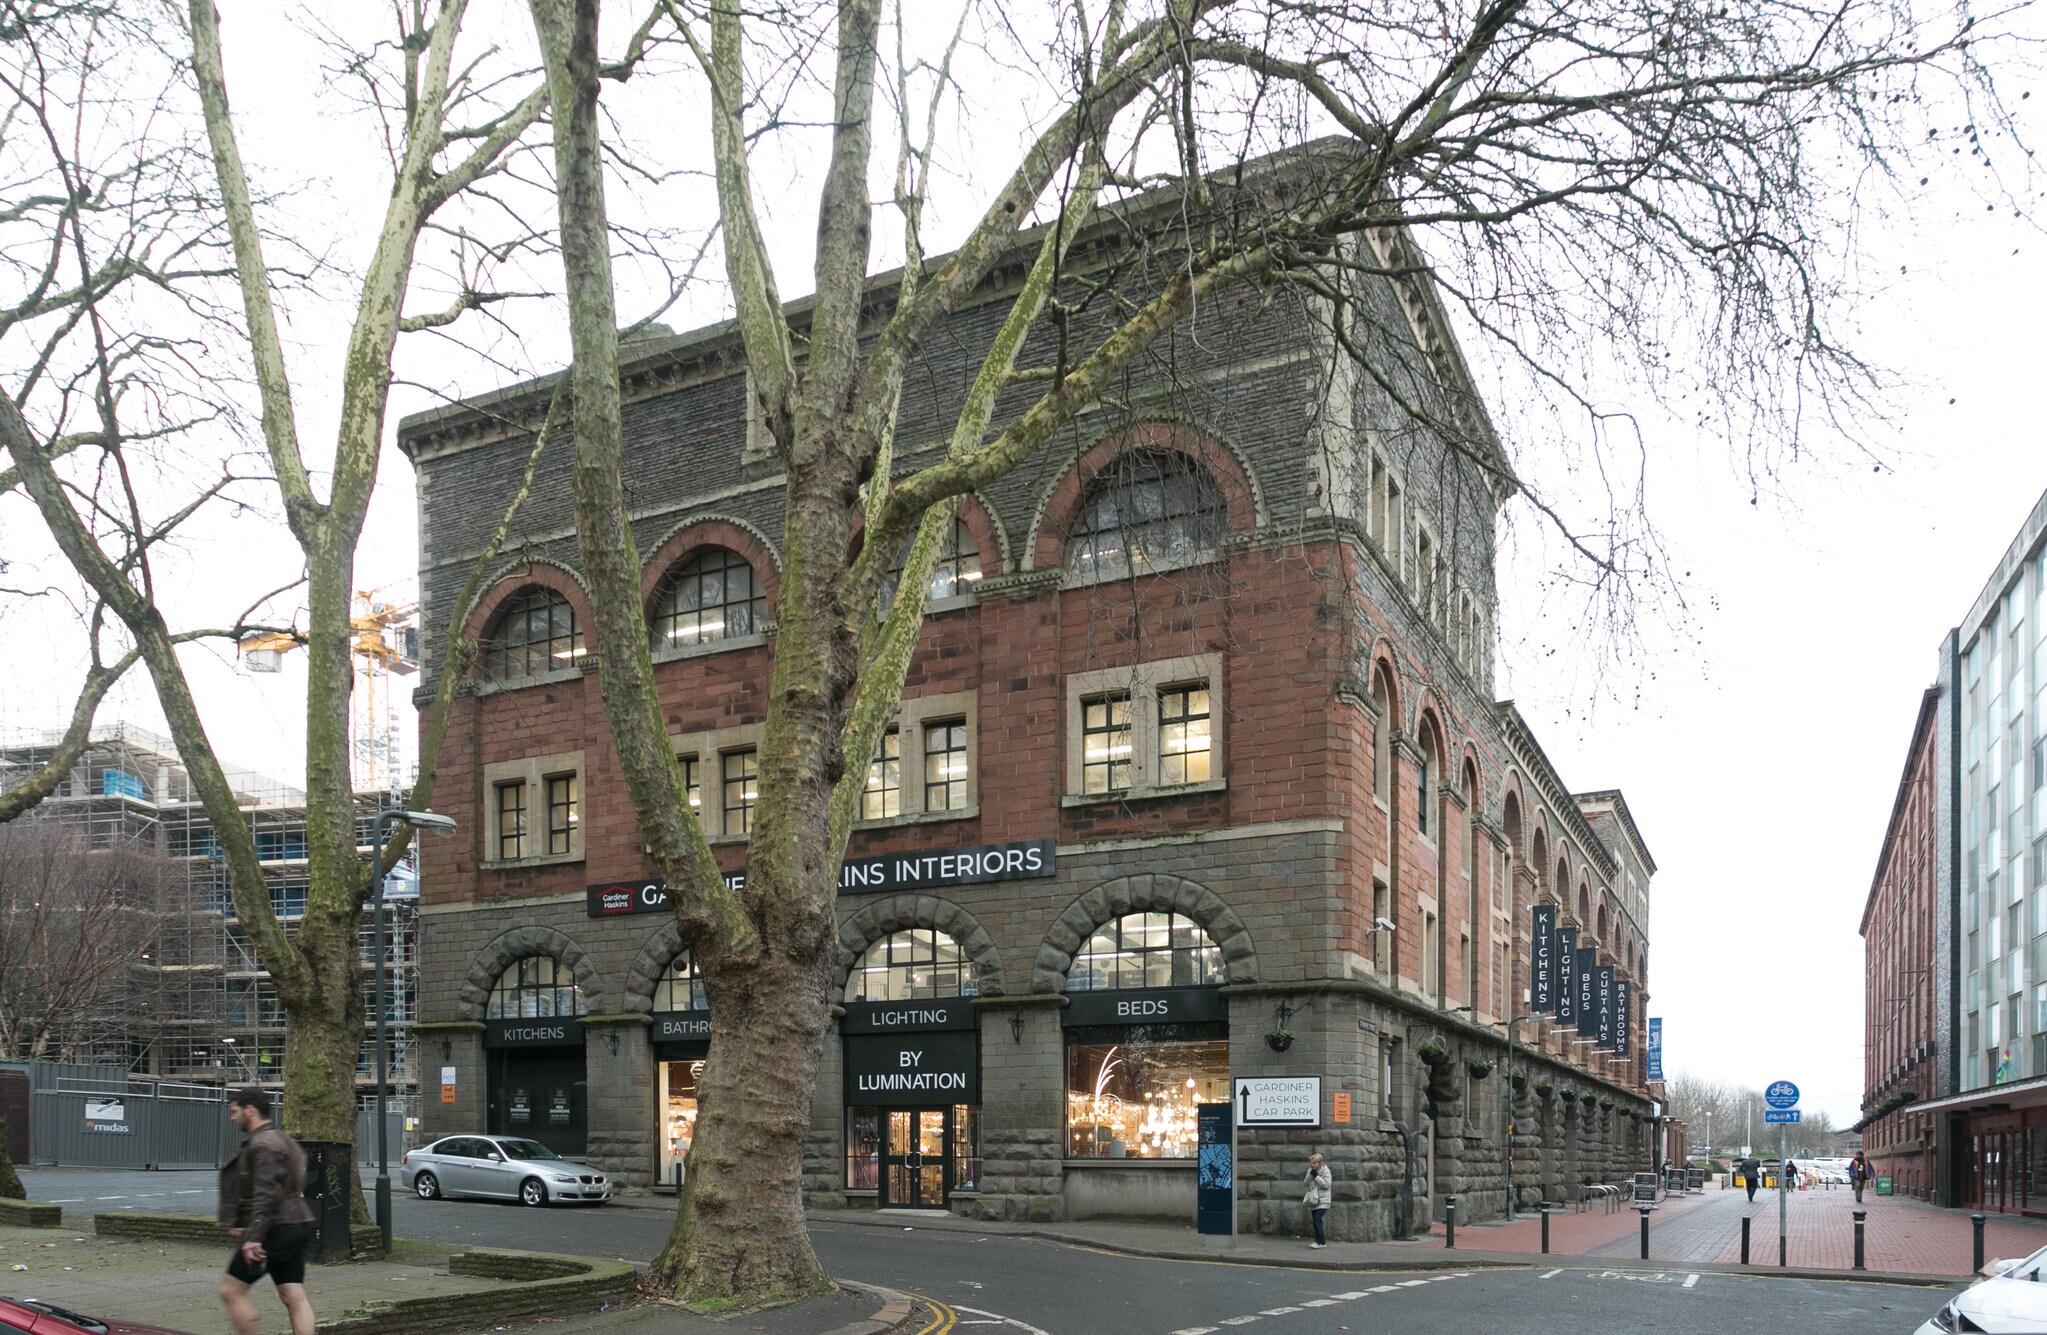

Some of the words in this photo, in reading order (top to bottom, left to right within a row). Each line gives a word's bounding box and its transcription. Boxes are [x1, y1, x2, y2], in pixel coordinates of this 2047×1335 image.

[895, 847, 1042, 882] INTERIORS
[602, 893, 629, 902] Gardiner
[604, 901, 628, 909] Haskins
[1538, 913, 1548, 1003] KITCHENS
[1561, 934, 1570, 1017] LIGHTING
[1582, 973, 1591, 1011] BEDS
[1117, 999, 1169, 1016] BEDS
[1600, 971, 1608, 1041] CURTAINS
[872, 1009, 947, 1026] LIGHTING
[1616, 983, 1626, 1052] BATHROOMS
[504, 1026, 565, 1041] KITCHENS
[663, 1020, 713, 1035] BATHR
[899, 1051, 922, 1067] BY
[859, 1072, 966, 1090] LUMINATION
[1254, 1082, 1313, 1093] GARDINER
[1259, 1094, 1310, 1105] HASKINS
[1253, 1107, 1278, 1117] CAR
[1283, 1107, 1314, 1117] PARK
[94, 1122, 129, 1132] midas
